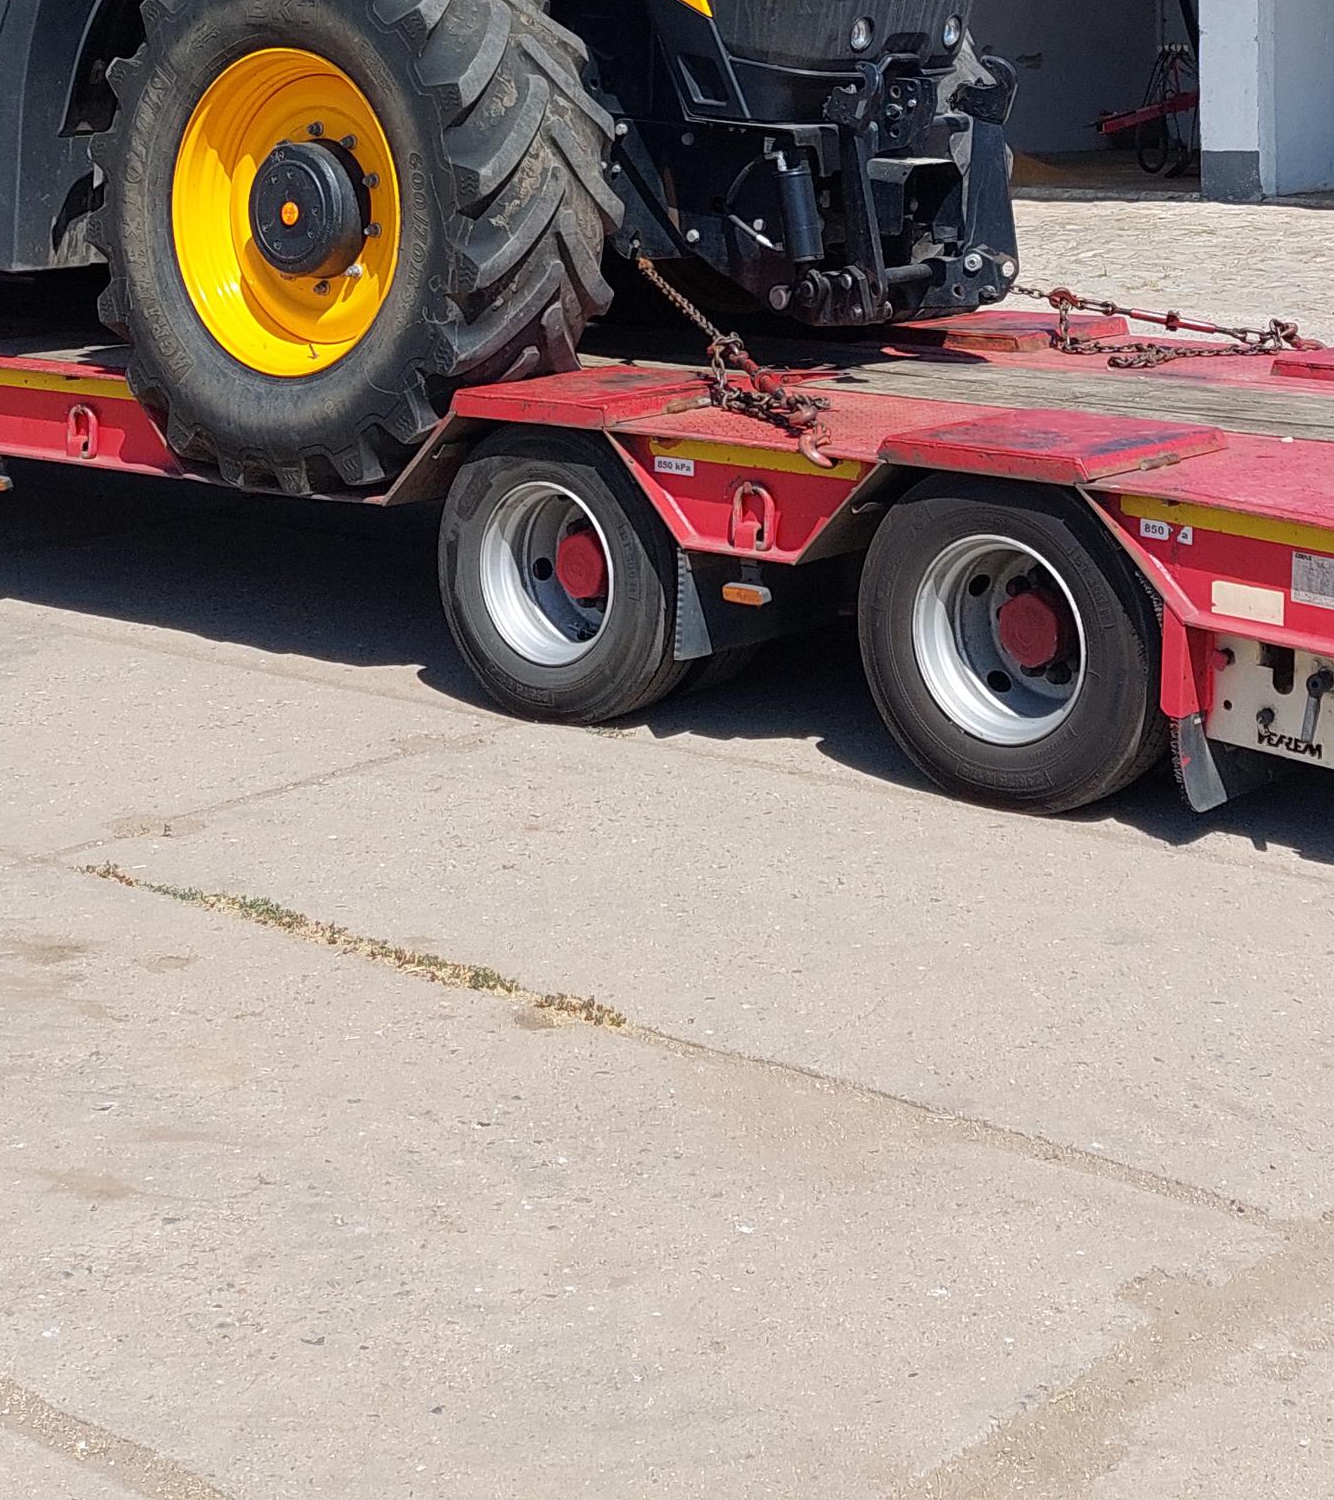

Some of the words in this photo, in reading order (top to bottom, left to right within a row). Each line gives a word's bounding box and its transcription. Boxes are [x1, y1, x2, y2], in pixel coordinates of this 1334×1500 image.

[657, 460, 673, 470] 850
[675, 462, 691, 472] kPa
[1144, 523, 1165, 536] 850
